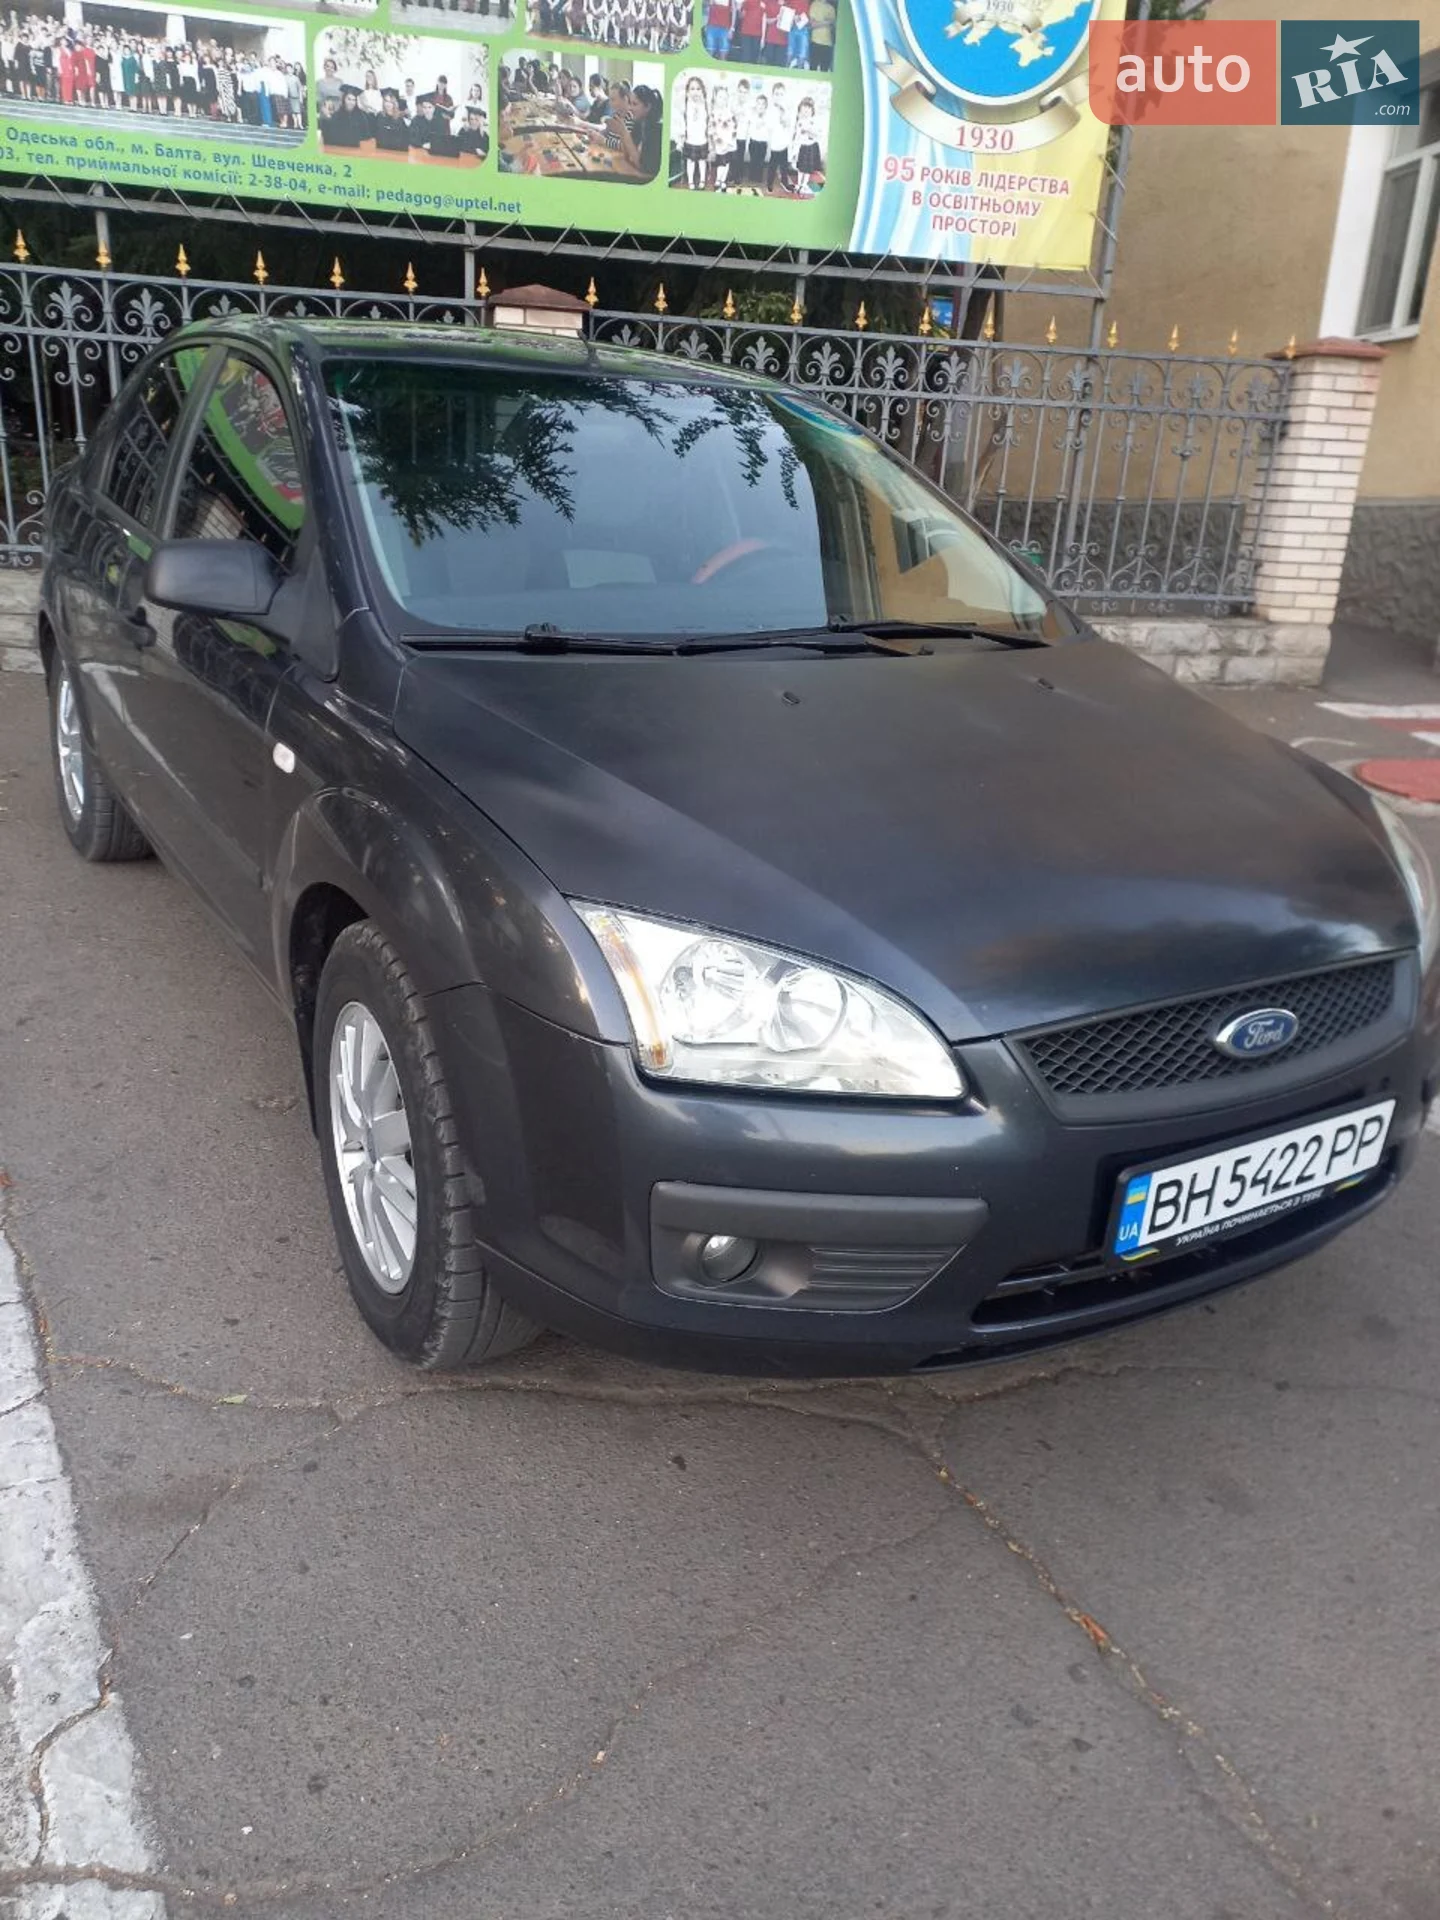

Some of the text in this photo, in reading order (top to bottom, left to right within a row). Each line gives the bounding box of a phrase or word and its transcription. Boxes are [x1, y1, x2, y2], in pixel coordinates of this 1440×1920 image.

[6, 126, 352, 178] Одеська обл., м. Балта, вул. Шевченка, 2
[956, 126, 1014, 151] 1930
[26, 152, 59, 165] тел.
[66, 154, 177, 178] приймальної
[182, 166, 243, 186] комісії:
[248, 173, 312, 194] 2-38-04,
[318, 181, 370, 199] e-mail:
[376, 187, 522, 215] pedagog@uptel.net
[884, 156, 1070, 195] 95 РОКІВ ЛІДЕРСТВА
[912, 191, 1041, 217] В ОСВІТНЬОМУ
[932, 215, 1016, 237] ПРОСТОРІ
[1244, 1019, 1285, 1049] Ford
[1118, 1221, 1139, 1242] UA
